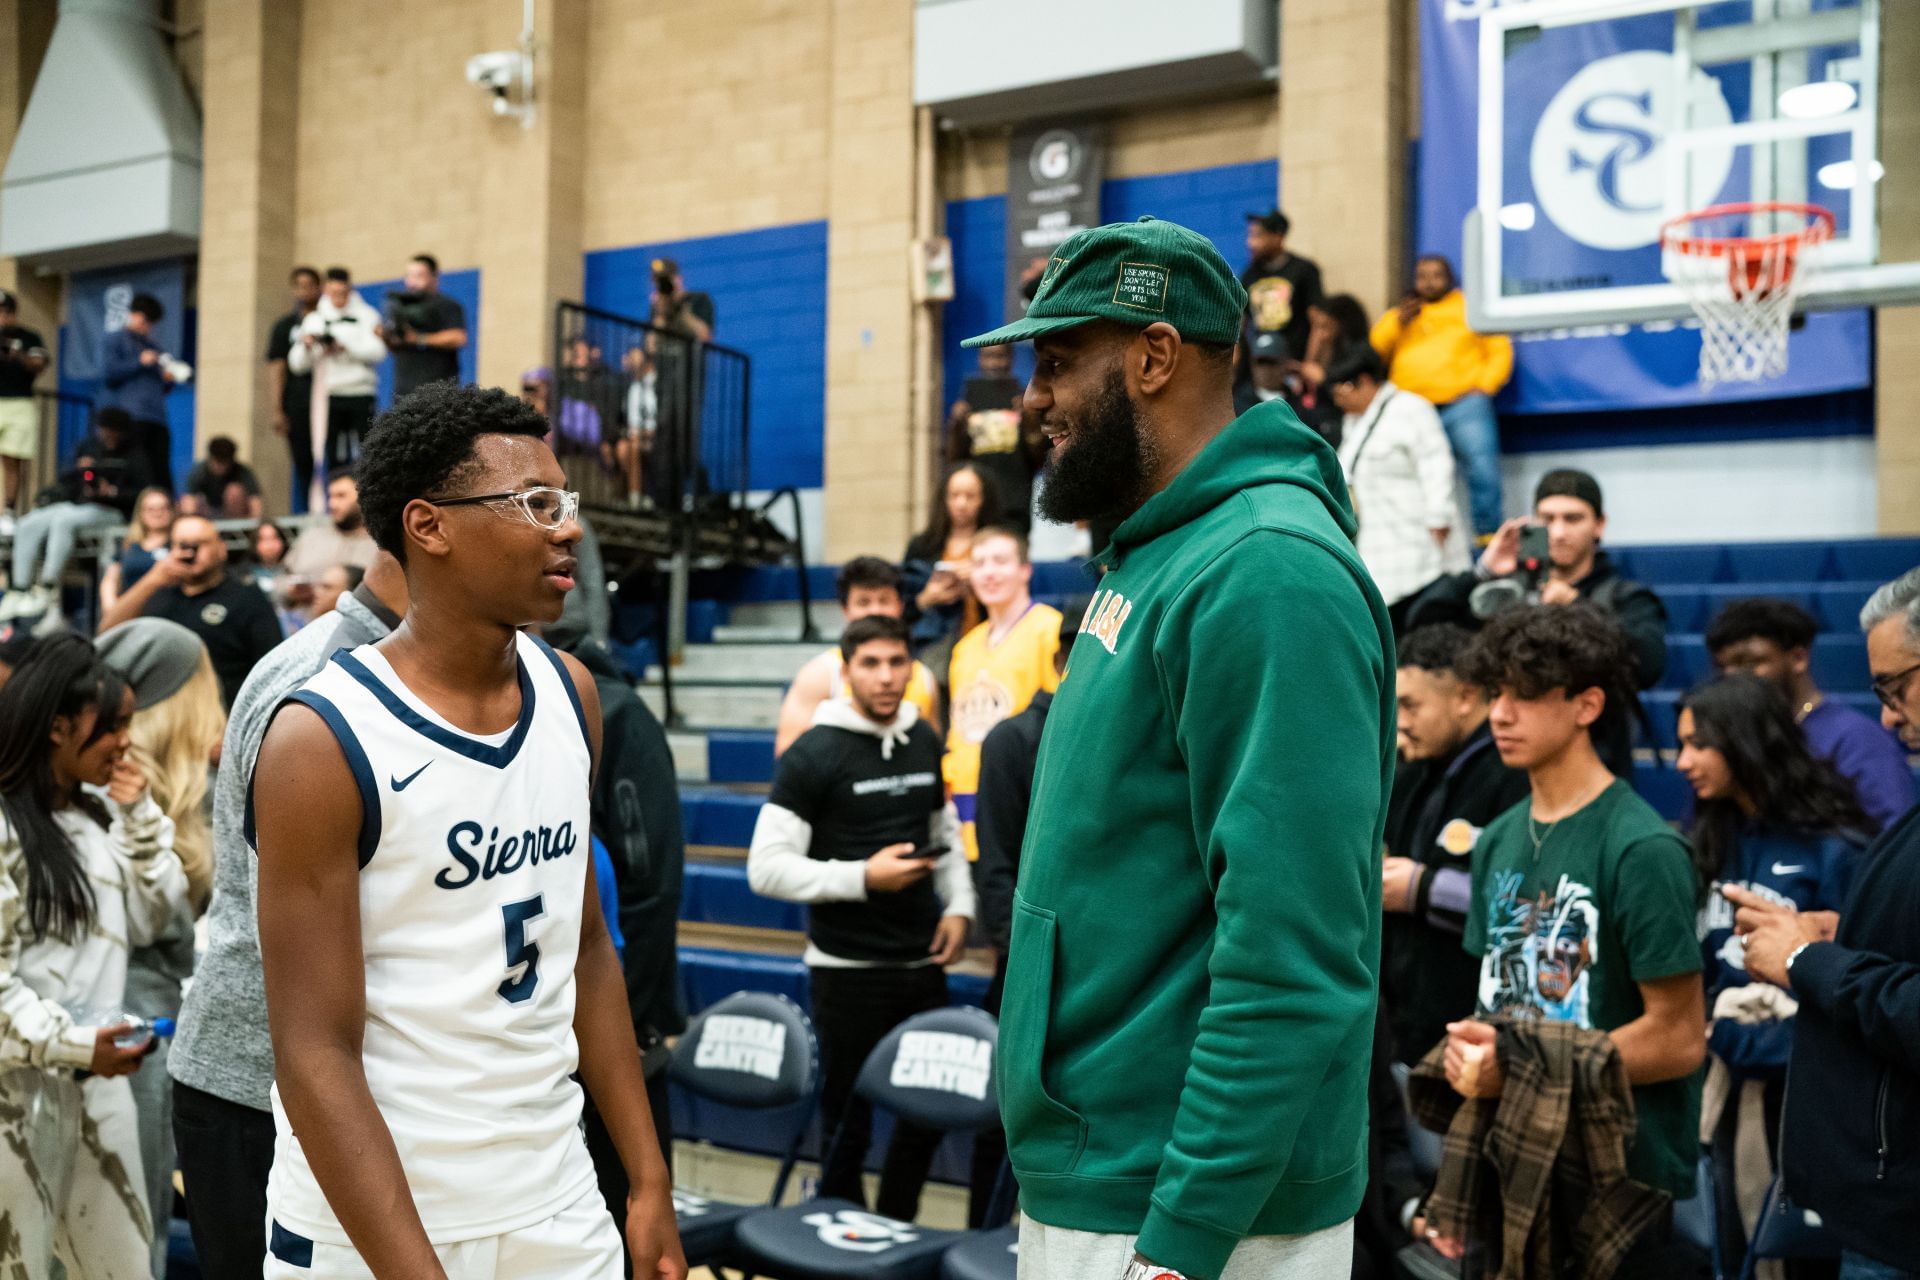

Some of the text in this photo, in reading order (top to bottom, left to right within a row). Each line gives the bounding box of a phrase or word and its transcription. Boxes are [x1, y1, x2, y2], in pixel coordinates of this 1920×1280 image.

[1124, 268, 1137, 277] USE
[1124, 276, 1160, 288] DON'T LET
[1120, 284, 1145, 294] SPORTS
[434, 820, 577, 890] Sierra
[496, 891, 548, 1009] 5
